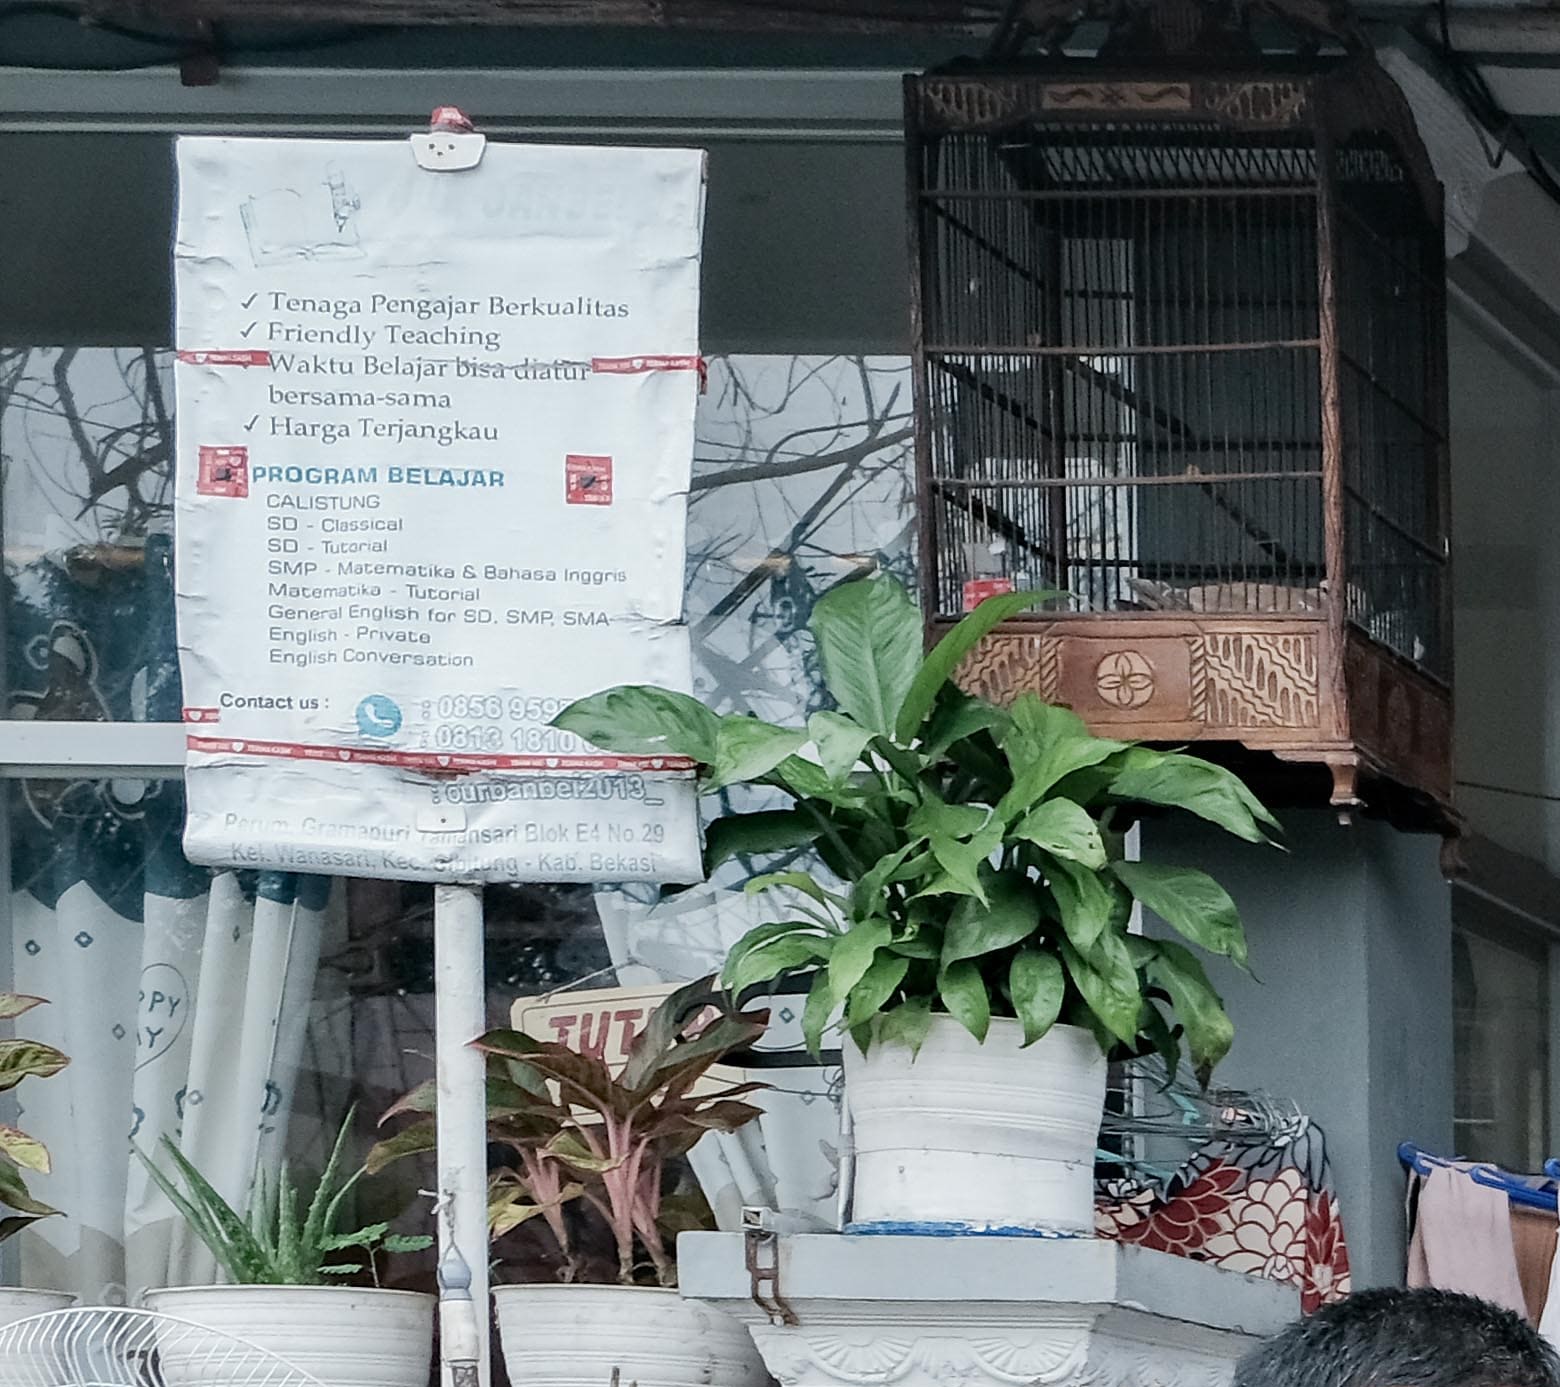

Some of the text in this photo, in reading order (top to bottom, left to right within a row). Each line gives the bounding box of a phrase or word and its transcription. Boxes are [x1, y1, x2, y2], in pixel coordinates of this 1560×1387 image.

[269, 292, 629, 319] Tenaga Pengajar Berkualitas
[269, 322, 500, 350] Friendly Teaching
[269, 353, 354, 377] Waktu
[365, 355, 447, 380] Belajar
[456, 357, 504, 379] bisa
[515, 360, 590, 382] diatur
[269, 385, 451, 409] bersama-sama
[270, 417, 498, 443] Harga Terjangkau
[252, 465, 504, 487] PROGRAM BELAJAR
[266, 494, 381, 510] CALISTUNG
[267, 516, 403, 532] SD Classical
[267, 538, 388, 554] SD Tutorial
[268, 560, 626, 584] SMP Matematika & Bahasa Inggris
[268, 583, 480, 600] Matematika Tutorial
[269, 604, 343, 620] General
[348, 605, 420, 624] English
[428, 605, 456, 622] for
[563, 610, 610, 627] SMA
[269, 627, 431, 646] English Private
[269, 649, 474, 667] English Conversation
[220, 693, 319, 709] Contact us
[437, 695, 503, 720] 0856
[435, 725, 503, 749] 0813
[511, 727, 576, 752] 1810
[525, 823, 571, 843] Blok
